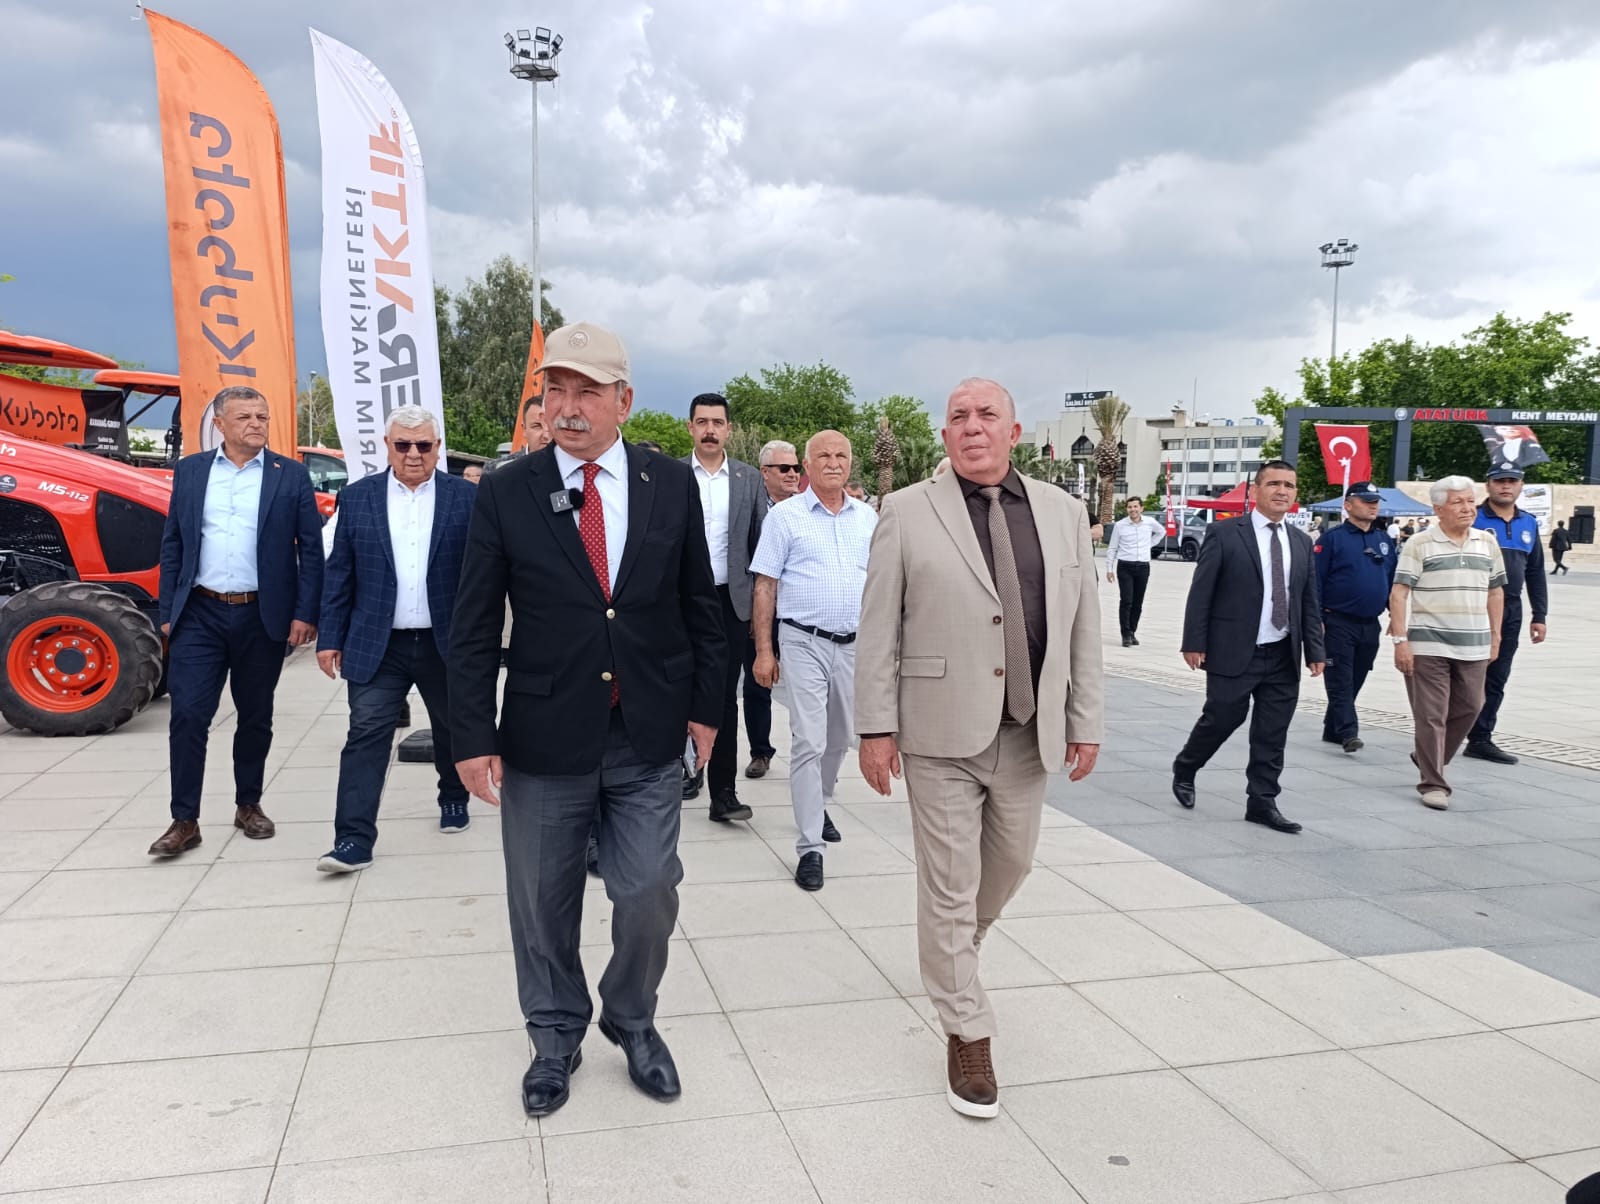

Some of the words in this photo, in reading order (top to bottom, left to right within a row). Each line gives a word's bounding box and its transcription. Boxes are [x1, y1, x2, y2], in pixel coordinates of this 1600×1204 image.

[0, 396, 79, 432] Kubota
[1413, 408, 1489, 421] ATATÜRK
[1511, 411, 1542, 421] KENT
[1545, 412, 1598, 422] MEYDANI
[37, 481, 90, 503] M5-112
